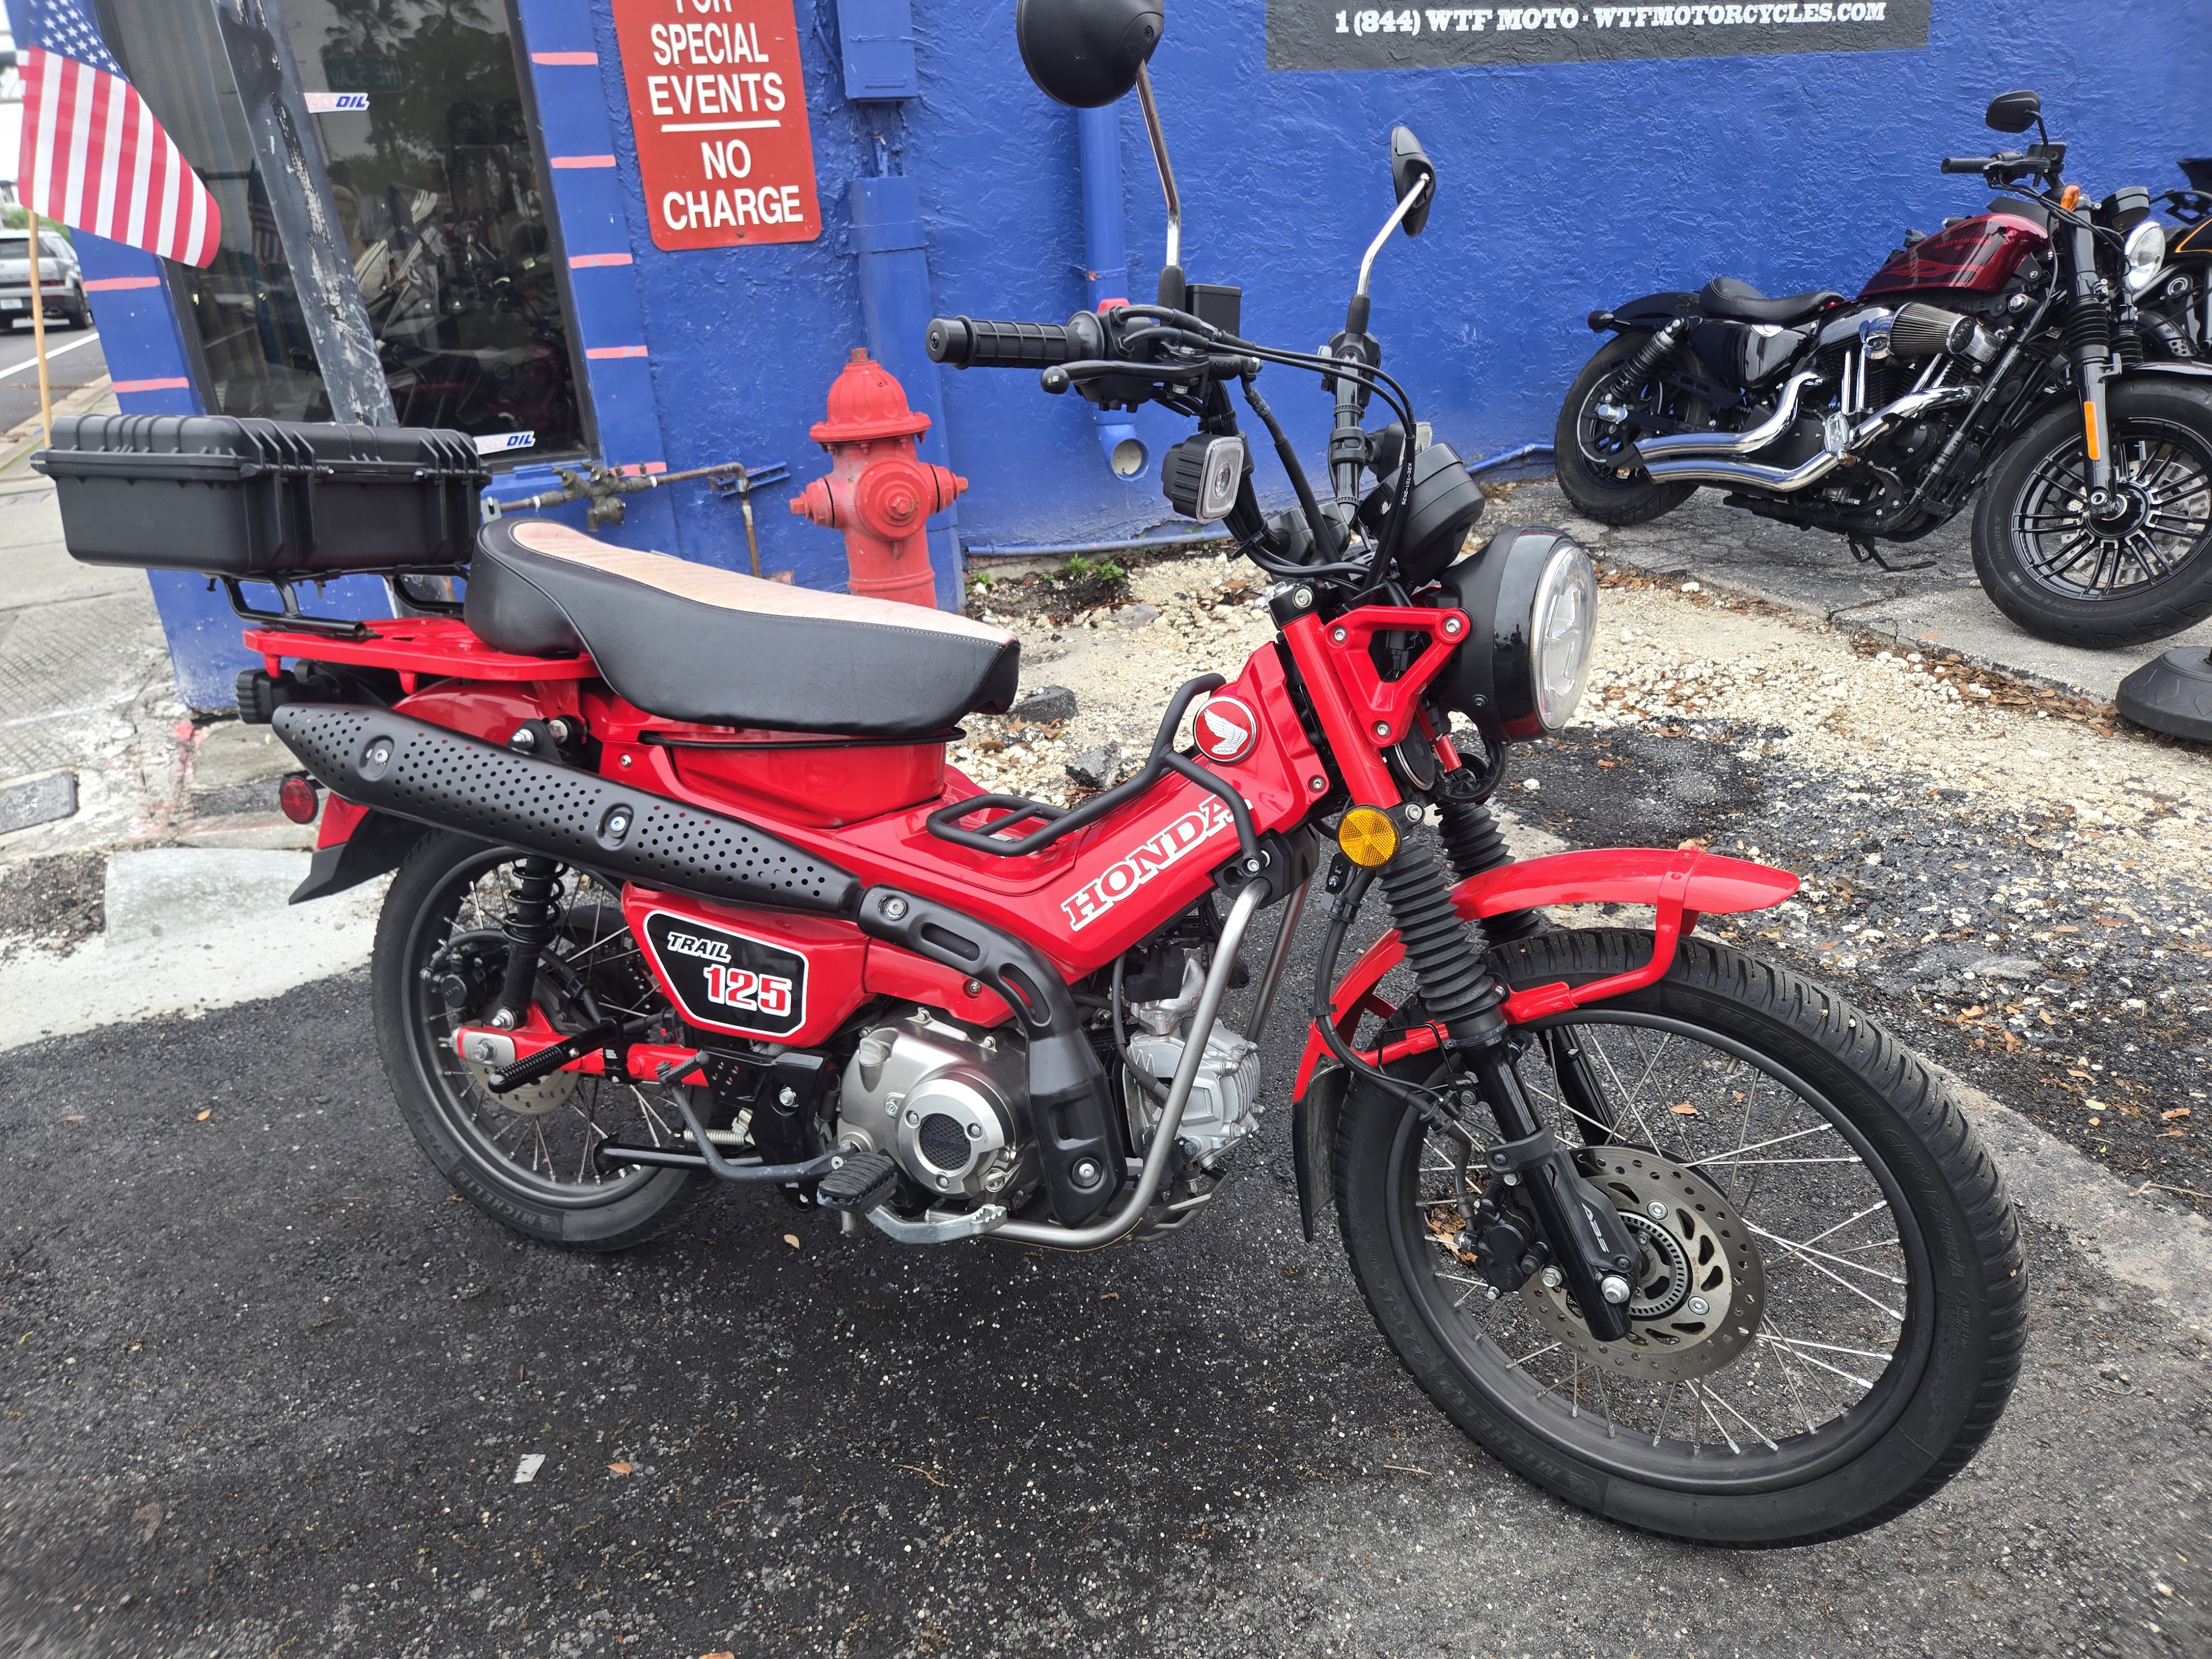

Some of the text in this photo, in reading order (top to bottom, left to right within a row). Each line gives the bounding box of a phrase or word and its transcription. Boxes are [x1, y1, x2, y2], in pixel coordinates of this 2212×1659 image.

[1335, 3, 1886, 37] 1 (844) WTF MOTO WTFMOTORCYCLES.COM
[650, 23, 769, 66] SPECIAL
[305, 95, 367, 109] MSOIL
[647, 72, 786, 116] EVENTS
[701, 139, 752, 180] NO
[663, 185, 804, 231] CHARGE
[1994, 525, 2006, 560] SCORCHER
[667, 931, 732, 963] TRAIL
[703, 964, 792, 1017] 125
[1714, 1008, 1885, 1118] MICHELIN
[456, 1170, 540, 1225] MICHELIN
[1882, 1129, 1966, 1279] CITY EXTRA
[1581, 1202, 1610, 1253] ABS
[1438, 1376, 1562, 1479] MICHELIN
